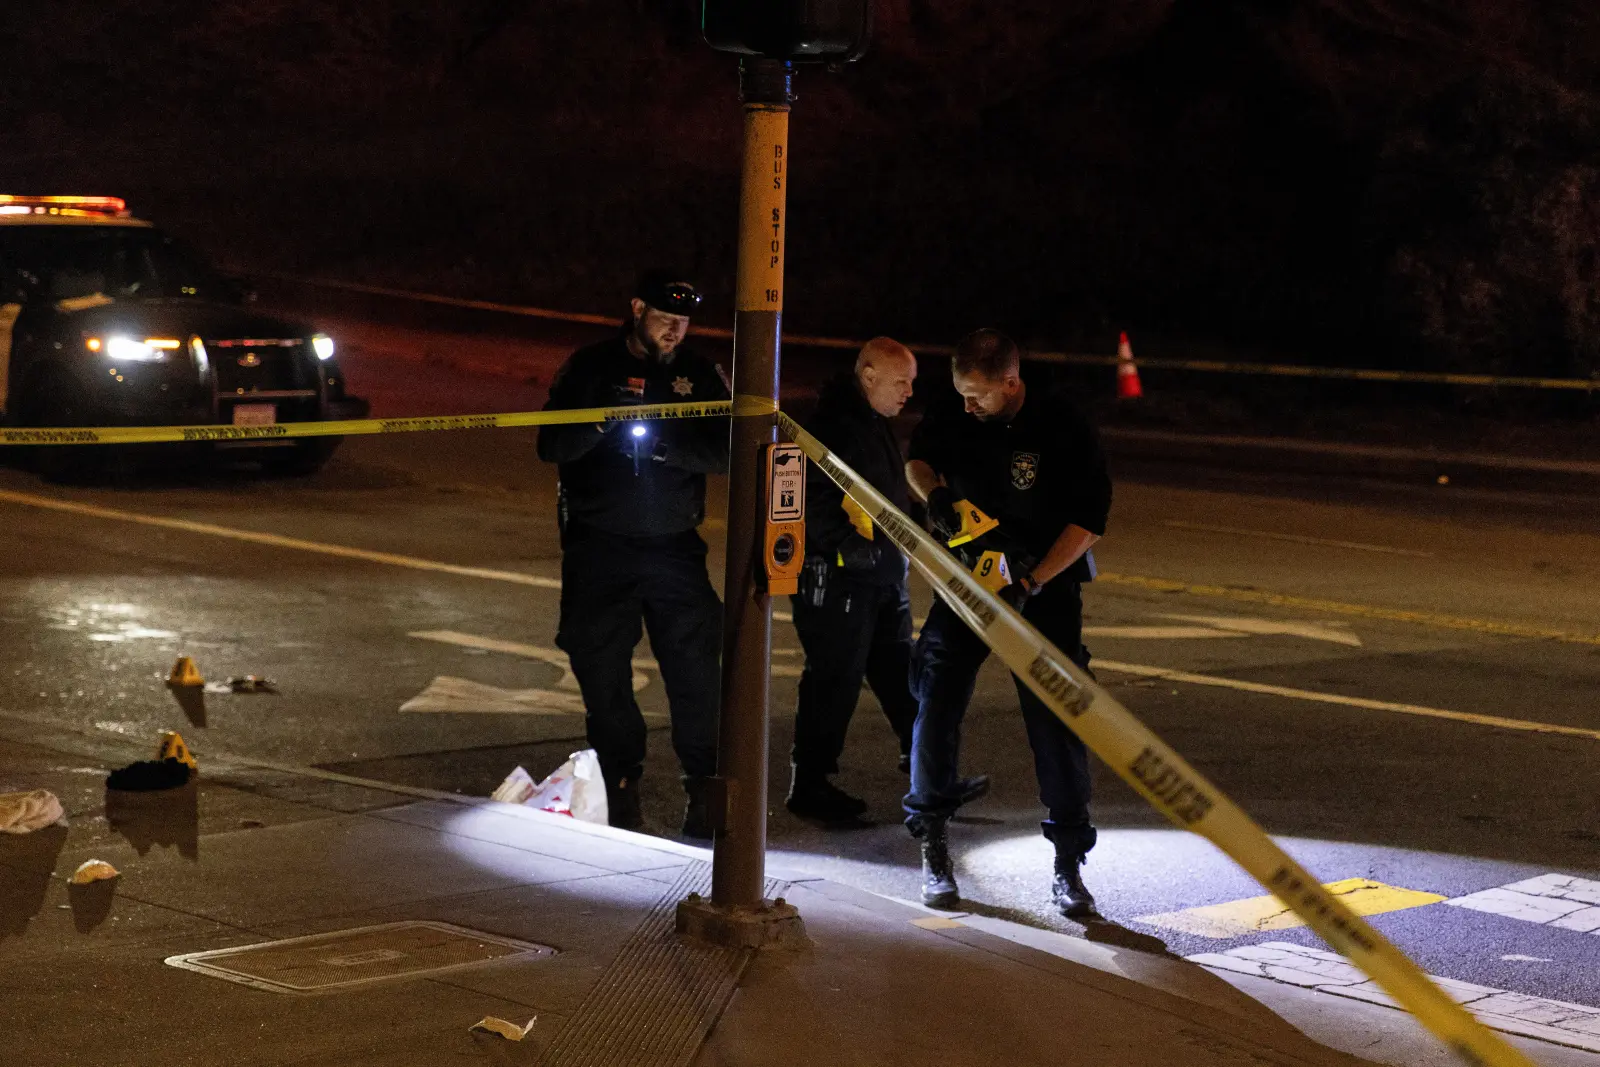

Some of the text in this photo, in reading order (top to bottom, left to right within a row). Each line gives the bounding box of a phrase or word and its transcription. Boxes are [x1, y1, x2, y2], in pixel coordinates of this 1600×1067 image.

[770, 144, 783, 268] BUS STOP
[765, 289, 779, 302] 18
[781, 480, 794, 488] FOR
[970, 510, 981, 523] 8
[980, 558, 993, 577] 9
